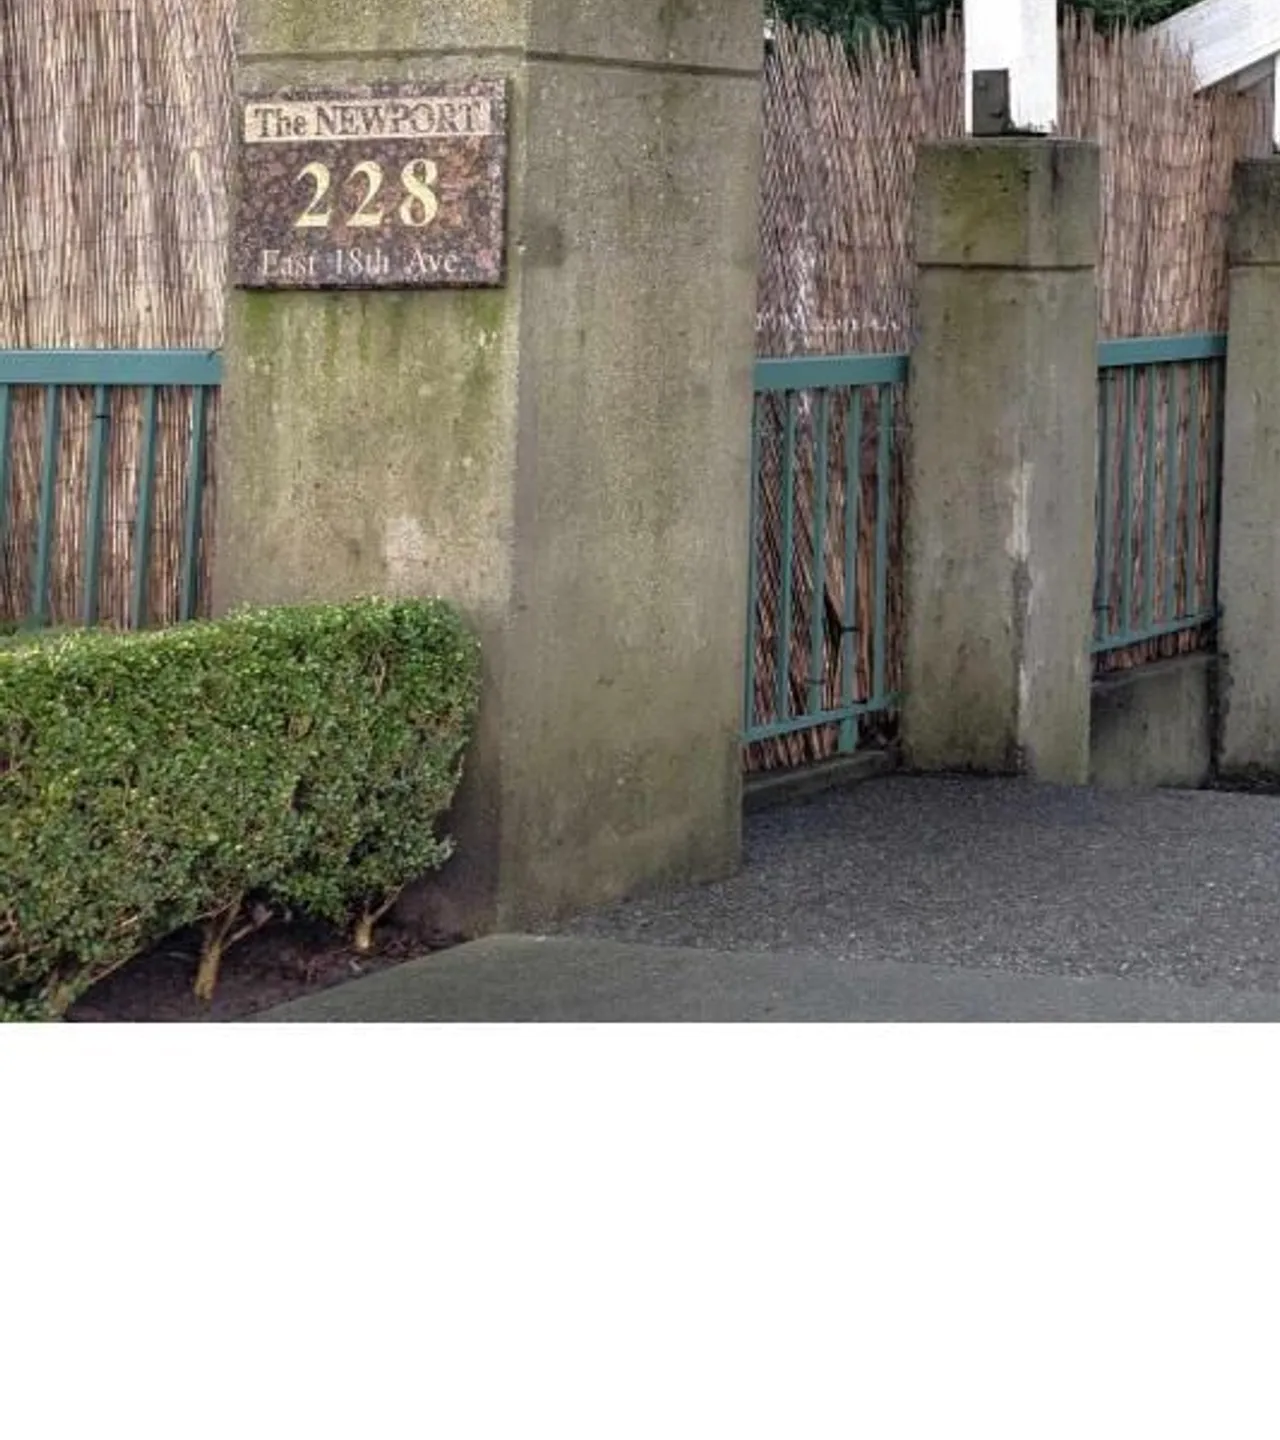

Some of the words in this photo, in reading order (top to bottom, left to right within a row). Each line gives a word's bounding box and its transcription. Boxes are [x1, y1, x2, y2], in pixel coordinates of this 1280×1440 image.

[254, 107, 309, 138] The
[315, 102, 484, 136] NEWPORT
[294, 158, 439, 228] 228
[262, 249, 316, 277] East
[335, 247, 390, 275] 18th
